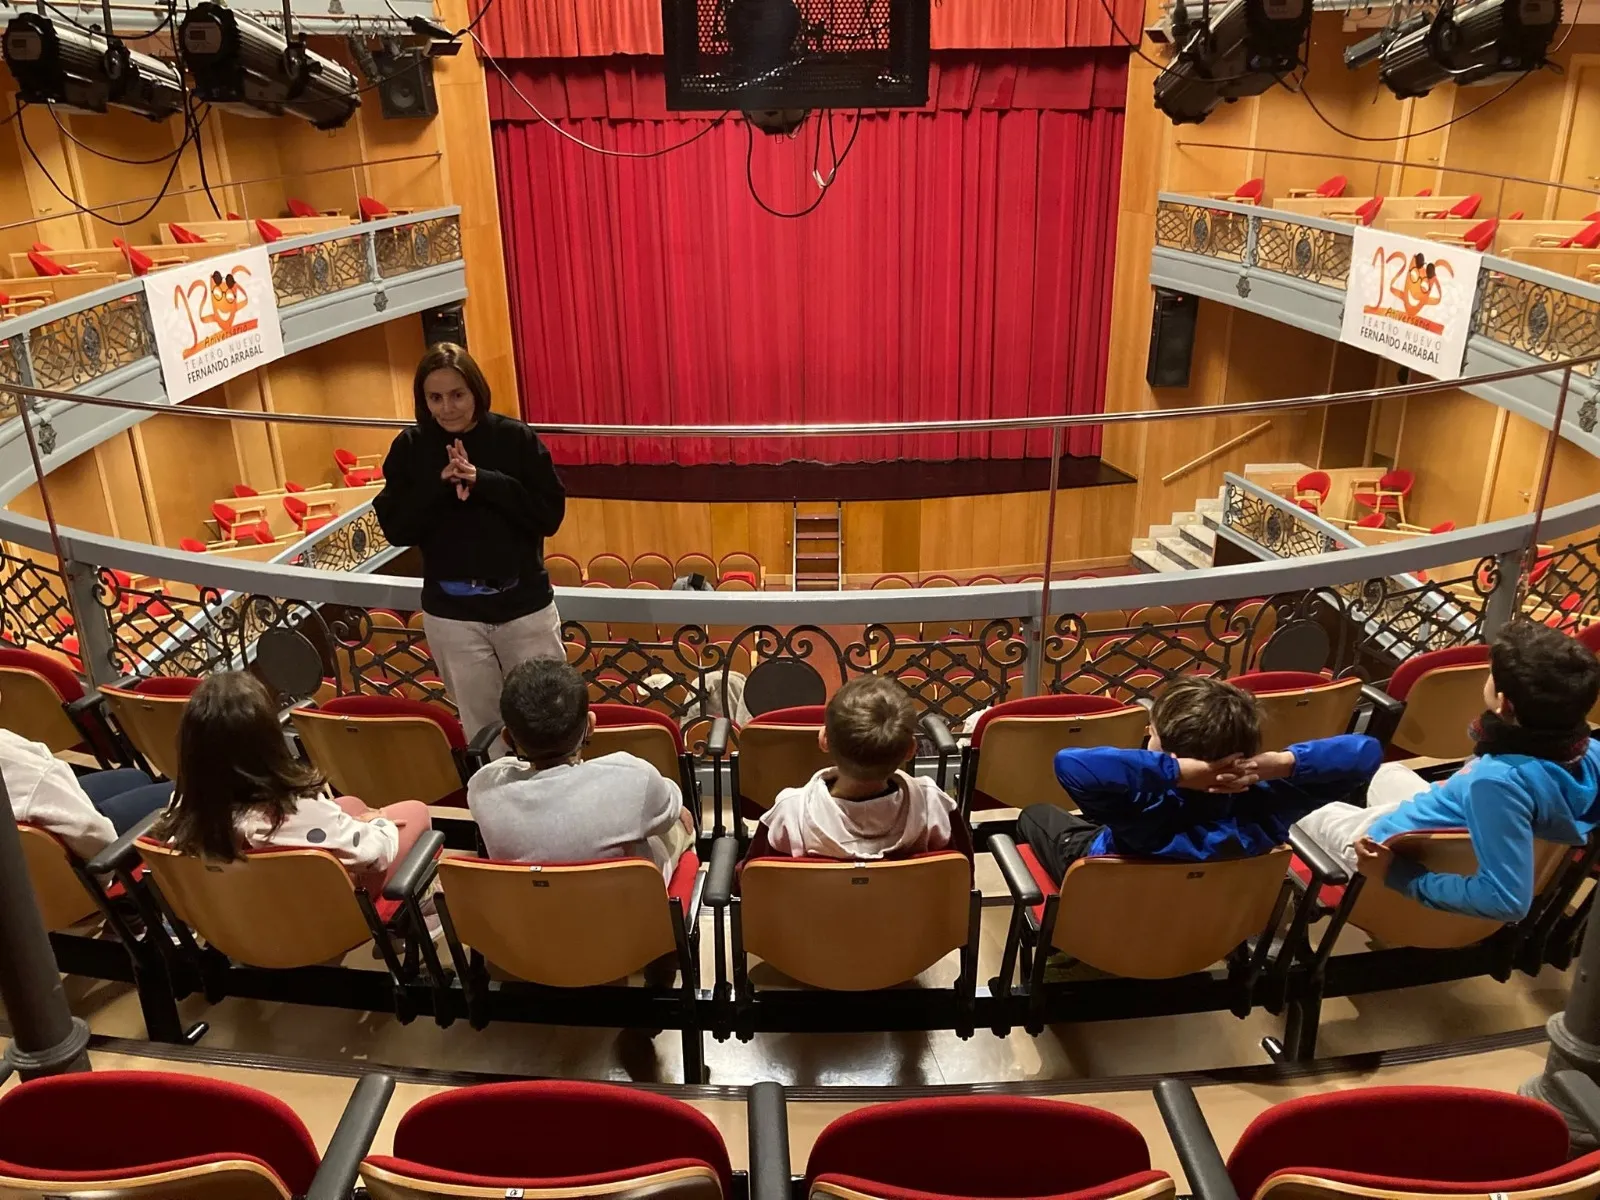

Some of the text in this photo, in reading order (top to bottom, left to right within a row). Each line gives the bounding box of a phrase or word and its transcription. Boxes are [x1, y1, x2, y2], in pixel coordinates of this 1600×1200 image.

[204, 325, 247, 347] Aniversario
[1363, 316, 1441, 350] TEATRO NUEVO
[1385, 307, 1429, 330] Aniversario
[185, 333, 261, 371] TEATRO NUEVO
[1360, 326, 1439, 364] FERNANDO ARRABAL
[187, 345, 263, 384] FERNANDO ARRABAL
